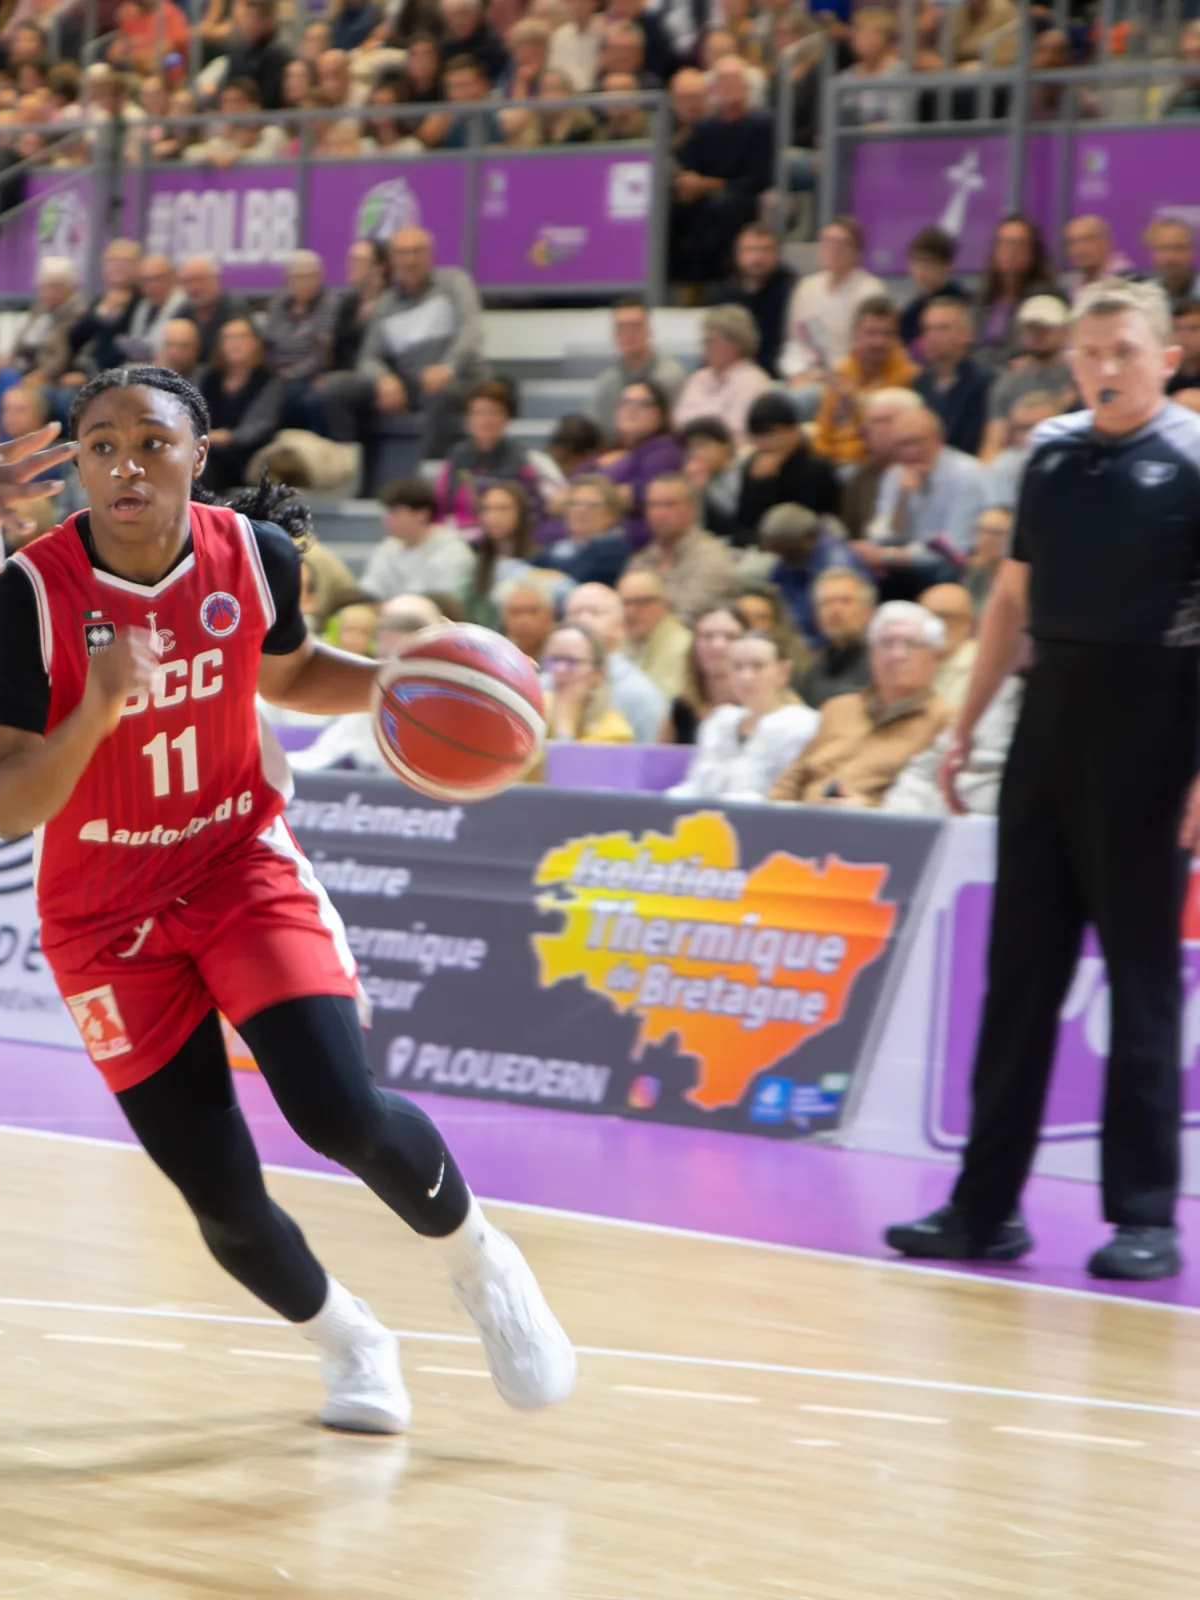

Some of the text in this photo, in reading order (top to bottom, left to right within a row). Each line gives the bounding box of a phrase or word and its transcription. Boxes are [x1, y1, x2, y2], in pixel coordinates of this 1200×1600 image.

[142, 725, 199, 798] 11
[288, 792, 464, 841] avalement
[312, 850, 411, 898] inture
[572, 846, 749, 901] Isolation
[347, 921, 488, 977] ermique
[585, 899, 848, 982] Thermique
[358, 963, 425, 1013] ieur
[605, 960, 829, 1030] de Bretagne
[411, 1042, 612, 1104] PLOUEDERN
